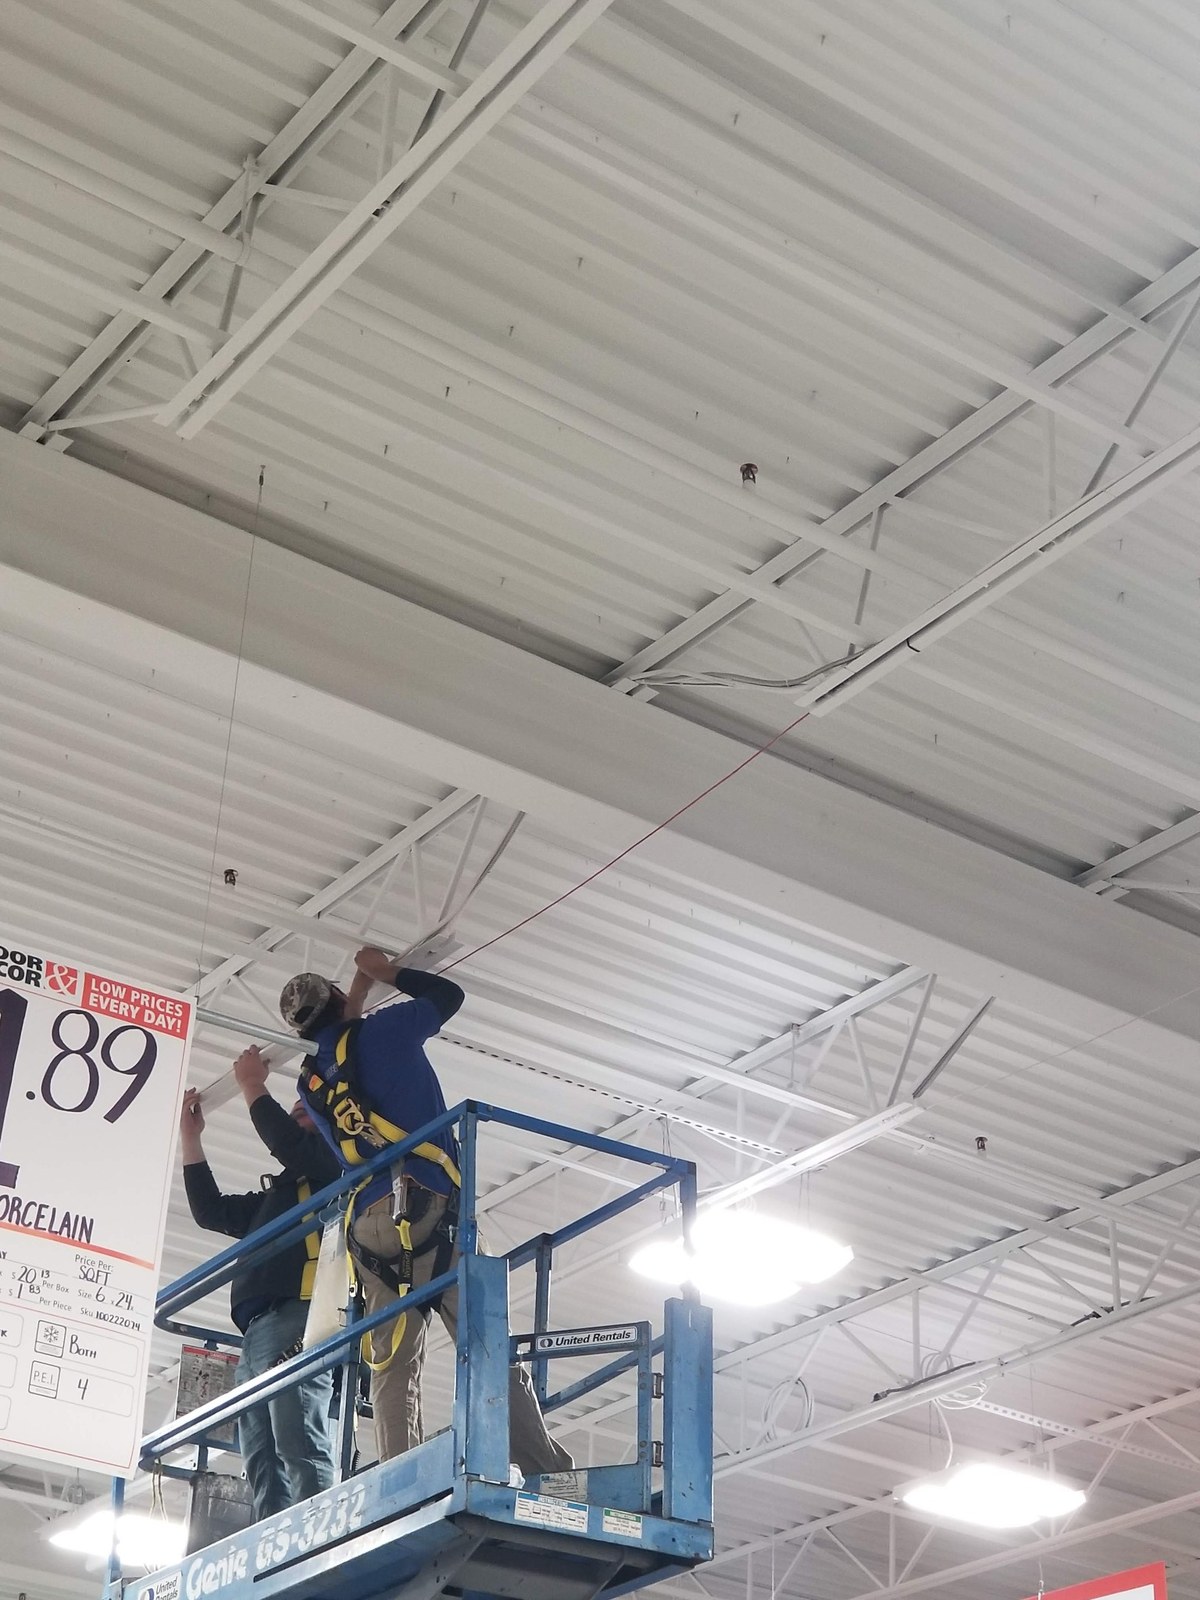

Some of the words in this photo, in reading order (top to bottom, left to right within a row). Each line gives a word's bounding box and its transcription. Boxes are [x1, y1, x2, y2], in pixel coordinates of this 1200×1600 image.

[91, 978, 126, 1000] LOW
[131, 990, 183, 1017] PRICES
[89, 993, 140, 1019] EVERY
[144, 1011, 182, 1033] DAY!
[74, 1253, 96, 1267] Price
[98, 1259, 114, 1272] Per:
[78, 1264, 112, 1286] SQFT
[42, 1280, 54, 1289] Per
[55, 1284, 70, 1293] Box
[39, 1297, 51, 1306] Per
[52, 1300, 73, 1312] Piece
[77, 1288, 93, 1299] Size
[95, 1286, 106, 1303] 6
[115, 1291, 133, 1311] 24
[80, 1307, 94, 1317] Sku
[555, 1334, 590, 1347] United
[592, 1330, 631, 1343] Rentals
[33, 1370, 56, 1386] P.E.I.
[77, 1378, 89, 1400] 4
[185, 1544, 249, 1600] Genie
[256, 1483, 367, 1571] GS-3232
[155, 1576, 178, 1595] United
